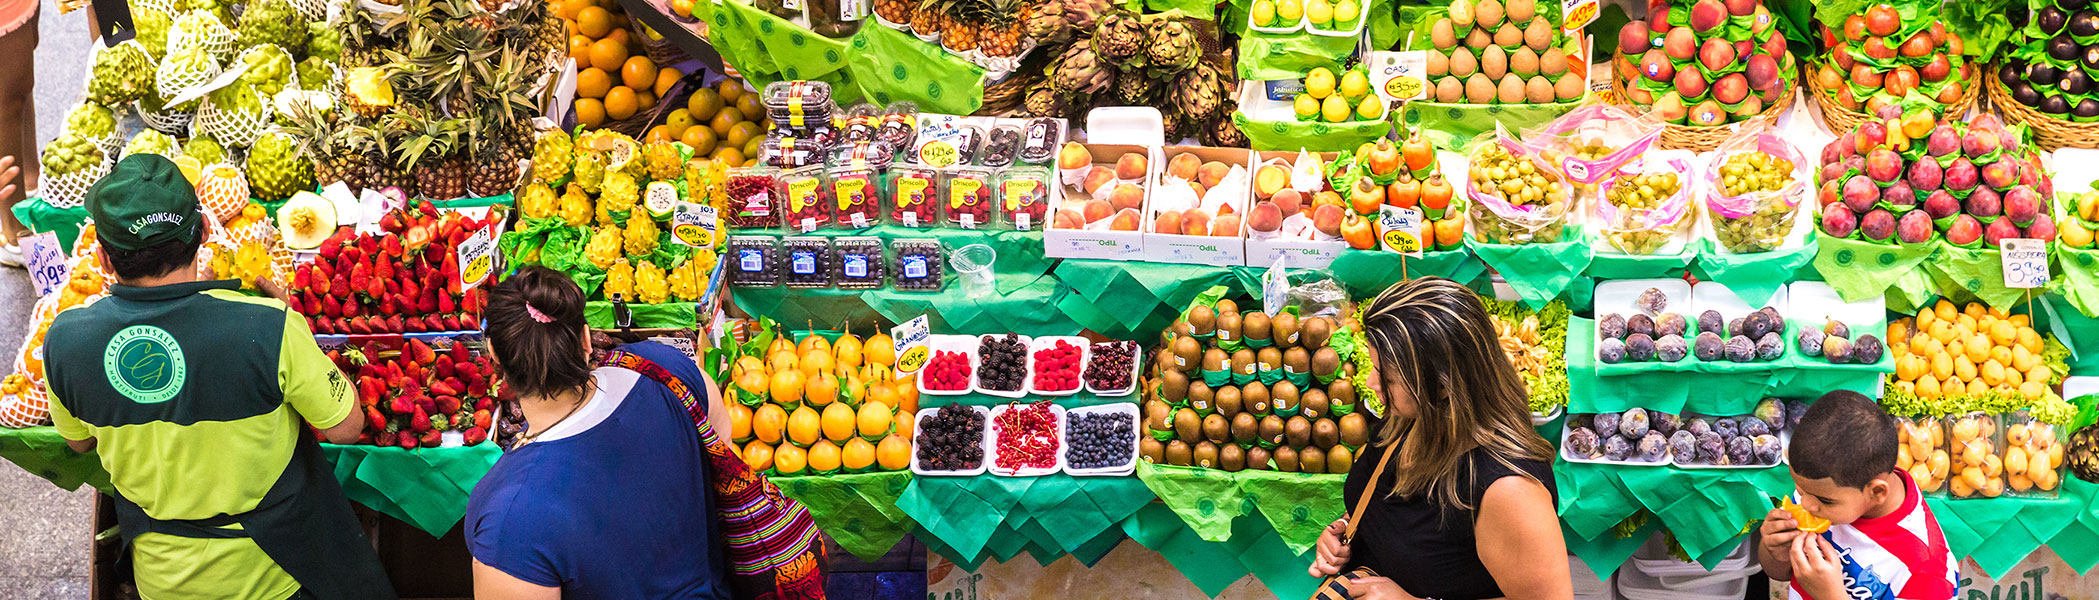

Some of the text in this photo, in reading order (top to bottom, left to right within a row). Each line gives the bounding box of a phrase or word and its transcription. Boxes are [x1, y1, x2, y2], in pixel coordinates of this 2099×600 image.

[108, 327, 179, 357] CASA GONSALEZ
[109, 370, 146, 401] HORTIFRUTI
